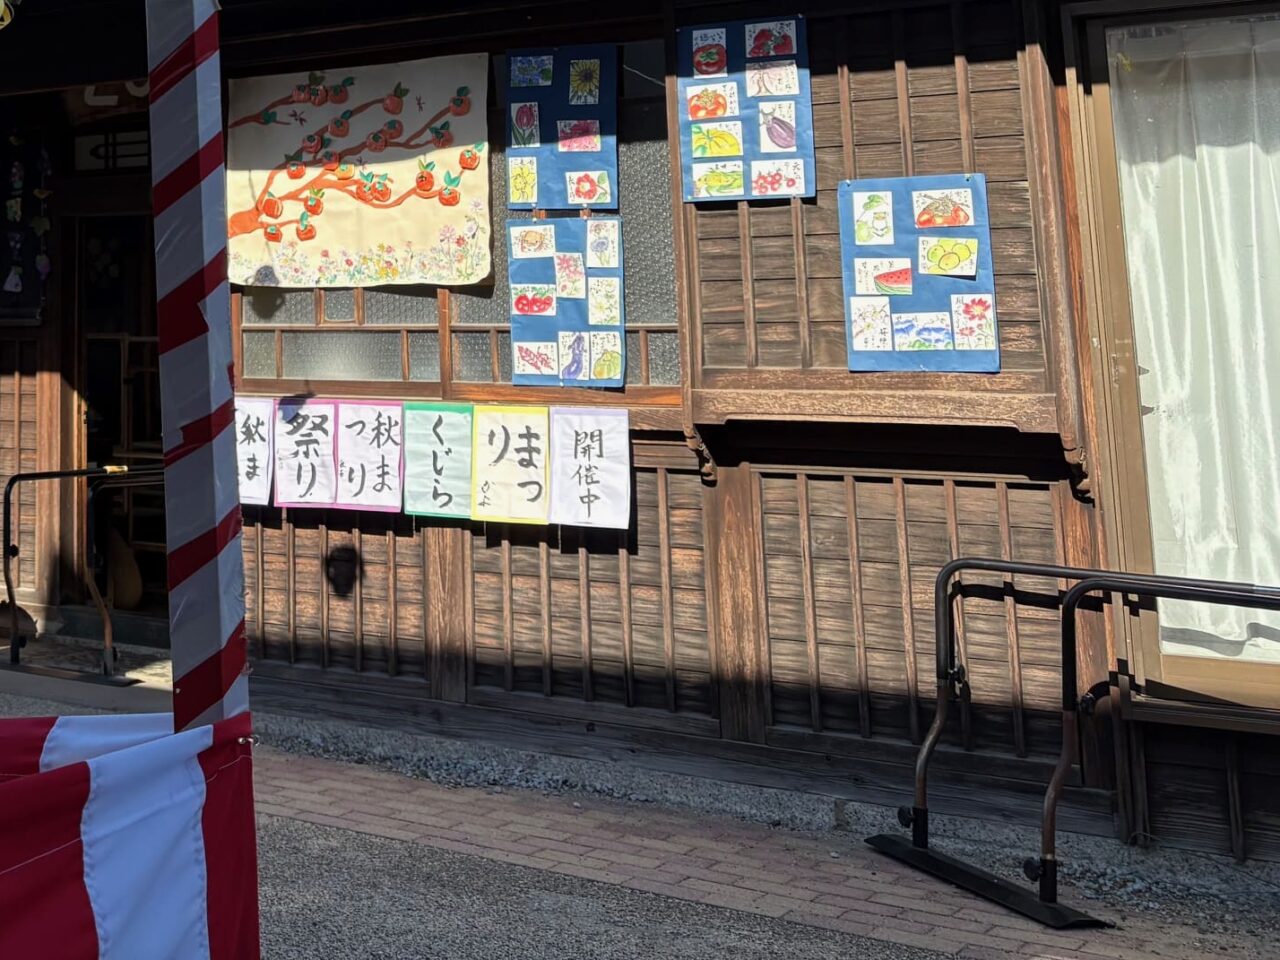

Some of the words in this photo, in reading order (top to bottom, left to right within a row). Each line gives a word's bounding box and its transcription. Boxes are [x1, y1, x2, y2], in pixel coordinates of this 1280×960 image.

[239, 413, 266, 481] 秋ま
[284, 412, 329, 498] 祭り
[432, 414, 453, 508] くじら
[570, 428, 604, 518] 開催中
